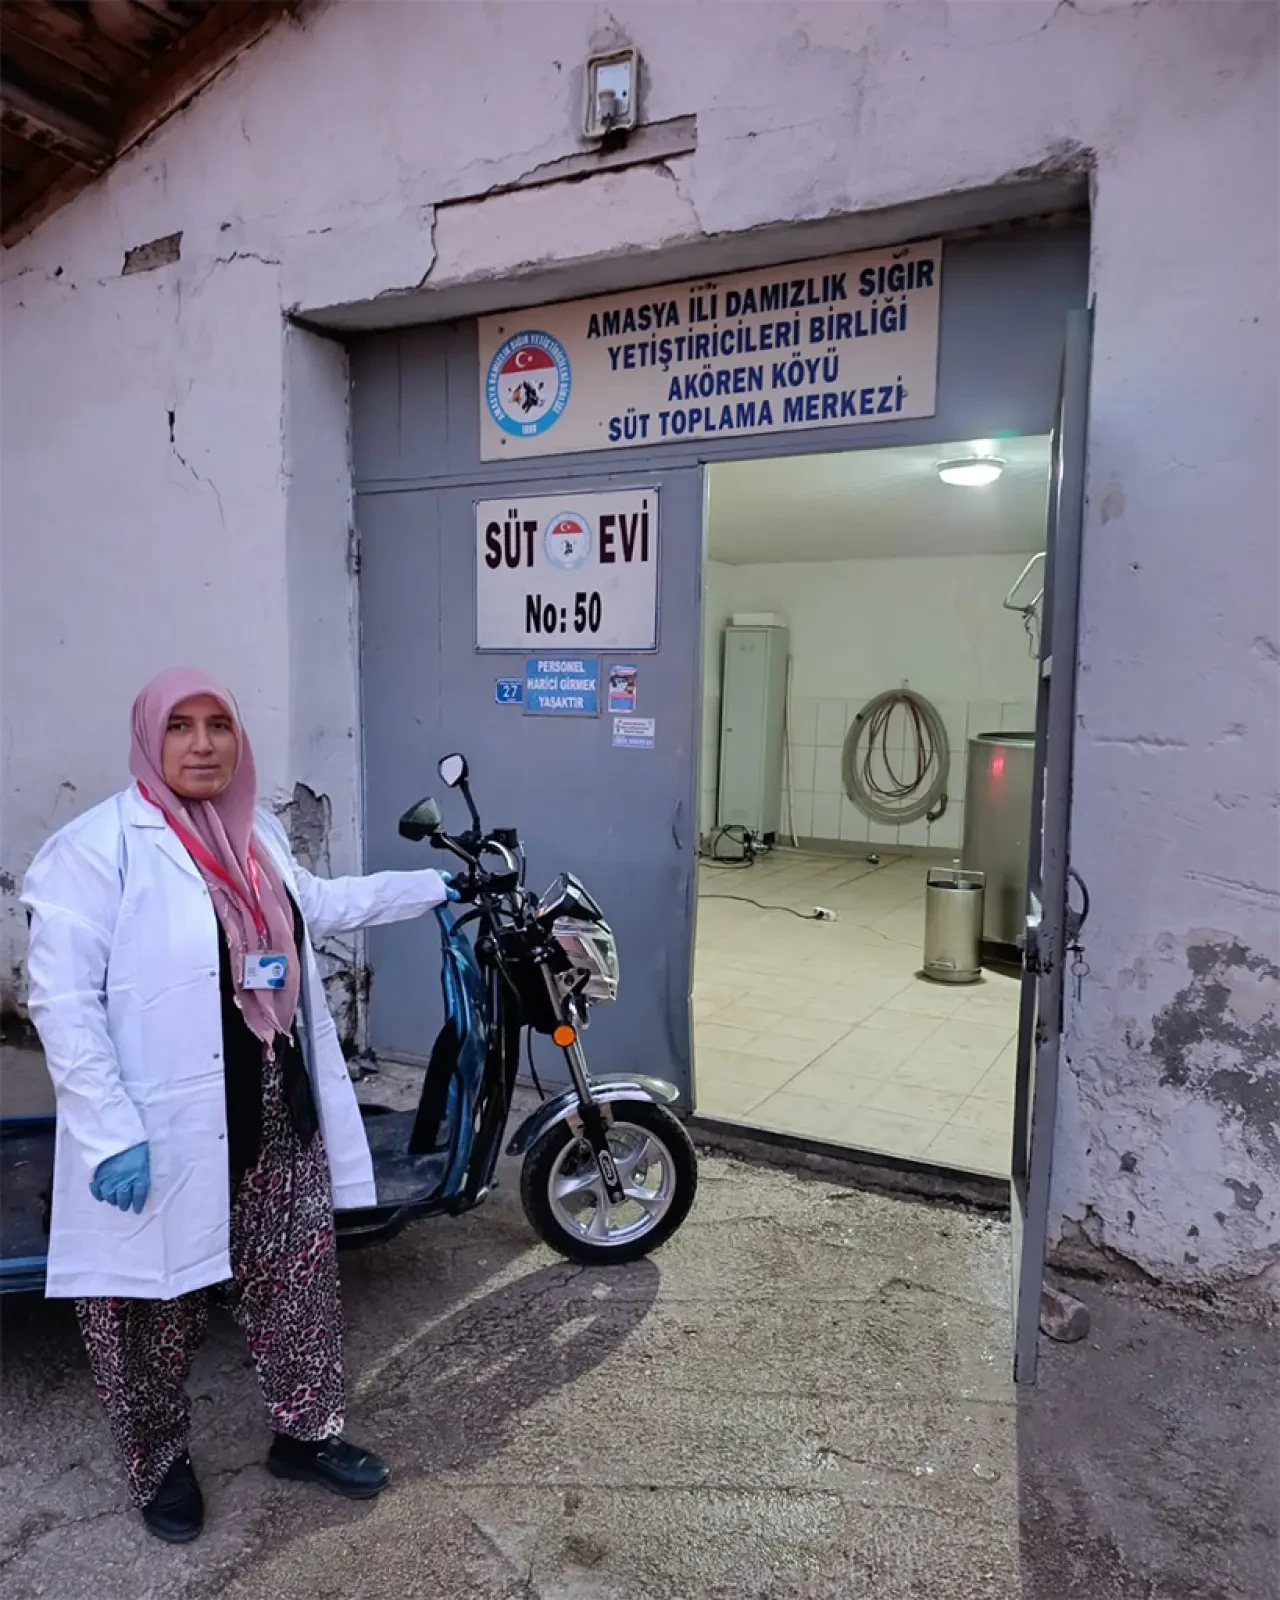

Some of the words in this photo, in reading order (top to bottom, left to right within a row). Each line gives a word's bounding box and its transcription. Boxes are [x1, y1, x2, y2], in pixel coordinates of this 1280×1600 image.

[587, 301, 679, 339] AMASYA
[688, 282, 718, 324] İLİ
[726, 272, 847, 318] DAMIZLIK
[858, 249, 935, 296] SIĞIR
[608, 311, 801, 372] YETİŞTİRİCİLERİ
[810, 295, 908, 343] BİRLİĞİ
[668, 363, 767, 402] AKÖREN
[772, 348, 840, 387] KÖYÜ
[608, 407, 650, 442] SÜT
[659, 401, 773, 436] TOPLAMA
[783, 375, 904, 423] MERKEZİ
[485, 508, 538, 570] SÜT
[599, 499, 649, 564] EVİ
[525, 594, 567, 634] No:
[573, 591, 602, 633] 50
[502, 685, 518, 698] 27
[537, 660, 586, 673] PERSONEL
[559, 676, 596, 692] GİRMEK
